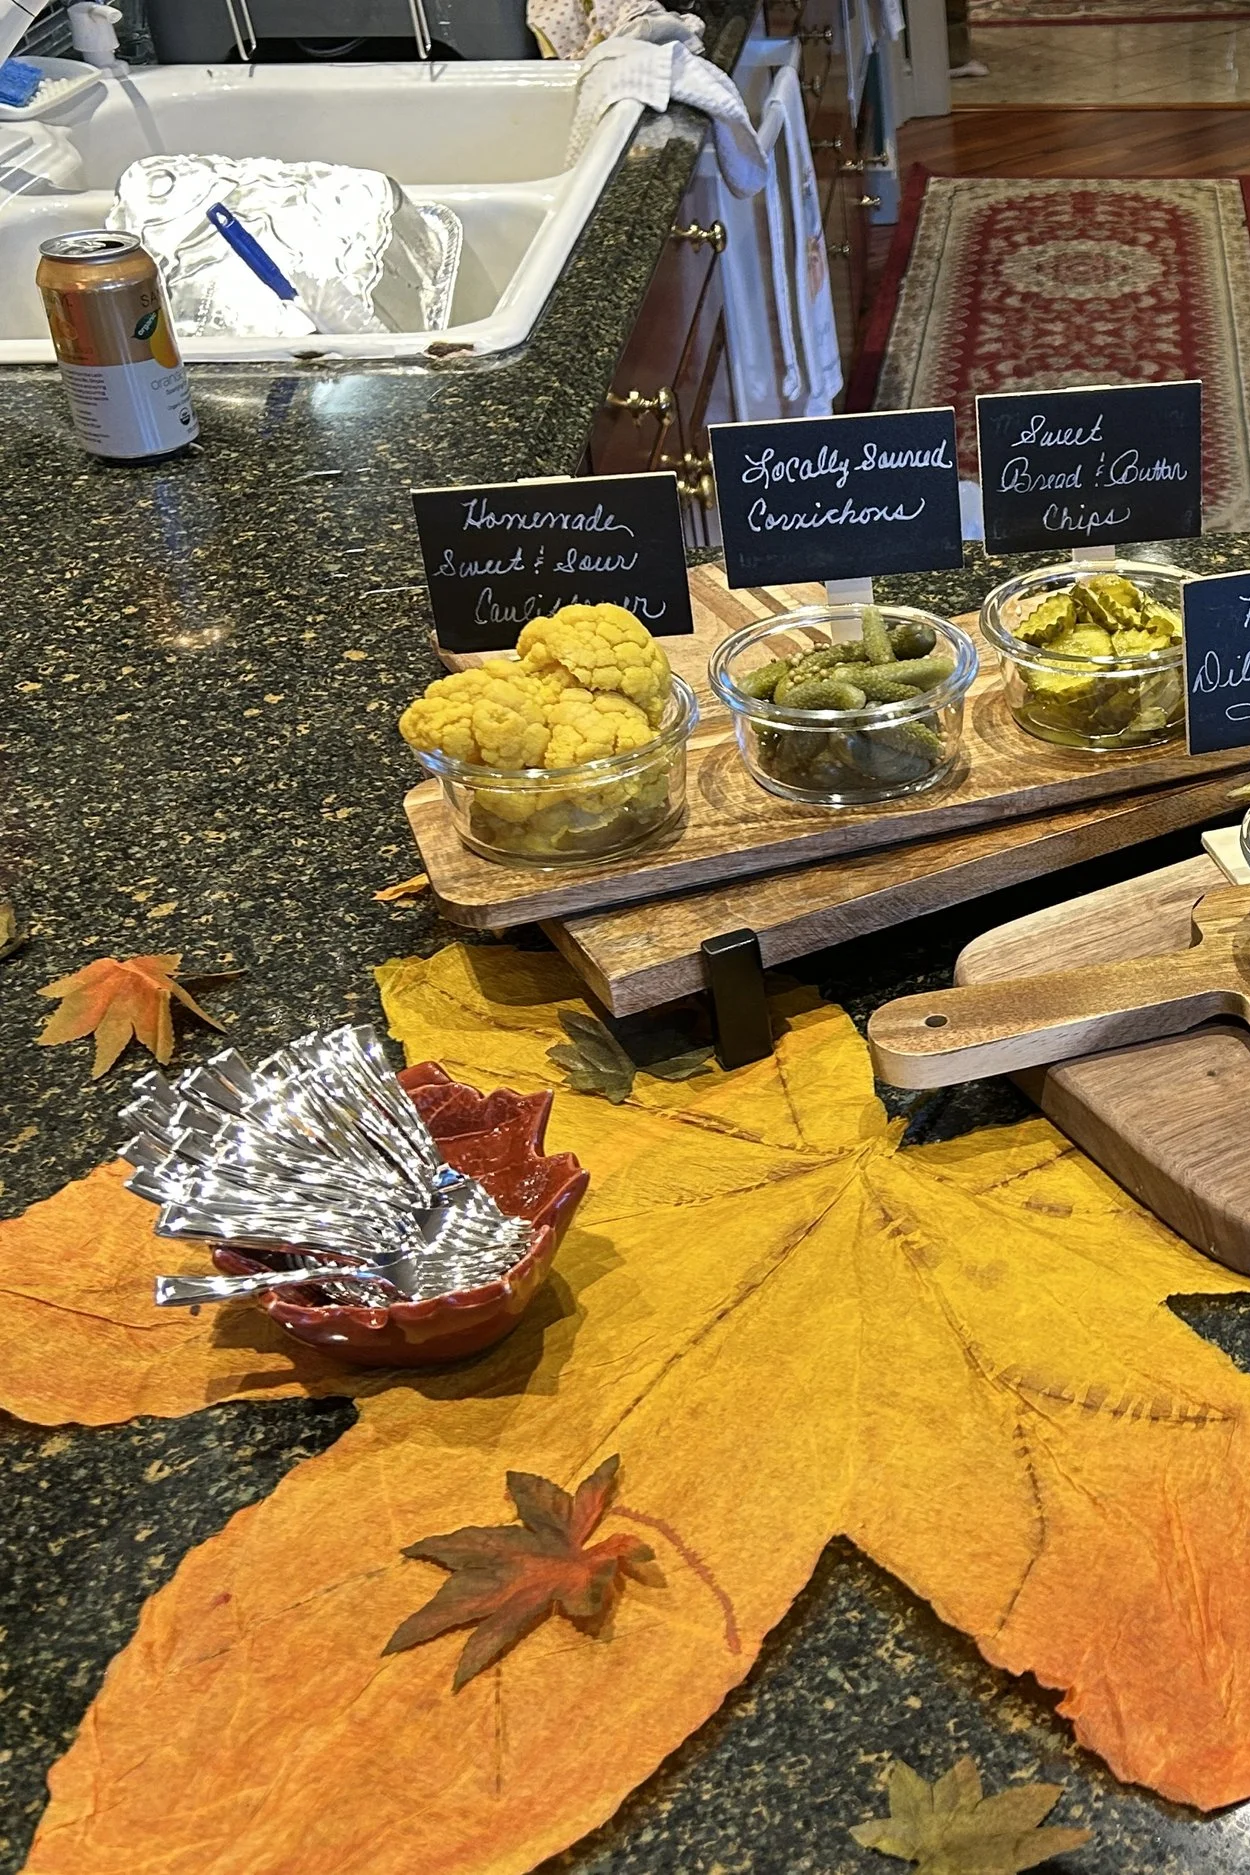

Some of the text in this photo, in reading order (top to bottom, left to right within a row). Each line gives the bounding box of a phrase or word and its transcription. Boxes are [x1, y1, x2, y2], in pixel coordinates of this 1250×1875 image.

[150, 370, 184, 390] oran
[1011, 414, 1103, 447] Sweet
[741, 439, 953, 489] Locally Sourced
[997, 456, 1083, 494] Bread
[1104, 449, 1188, 487] Butter
[461, 498, 635, 538] Homemade
[747, 498, 926, 533] Cornichons
[1043, 503, 1131, 537] Chips
[434, 547, 525, 579] Sweet
[553, 547, 639, 574] Sour
[474, 586, 667, 626] Caulier
